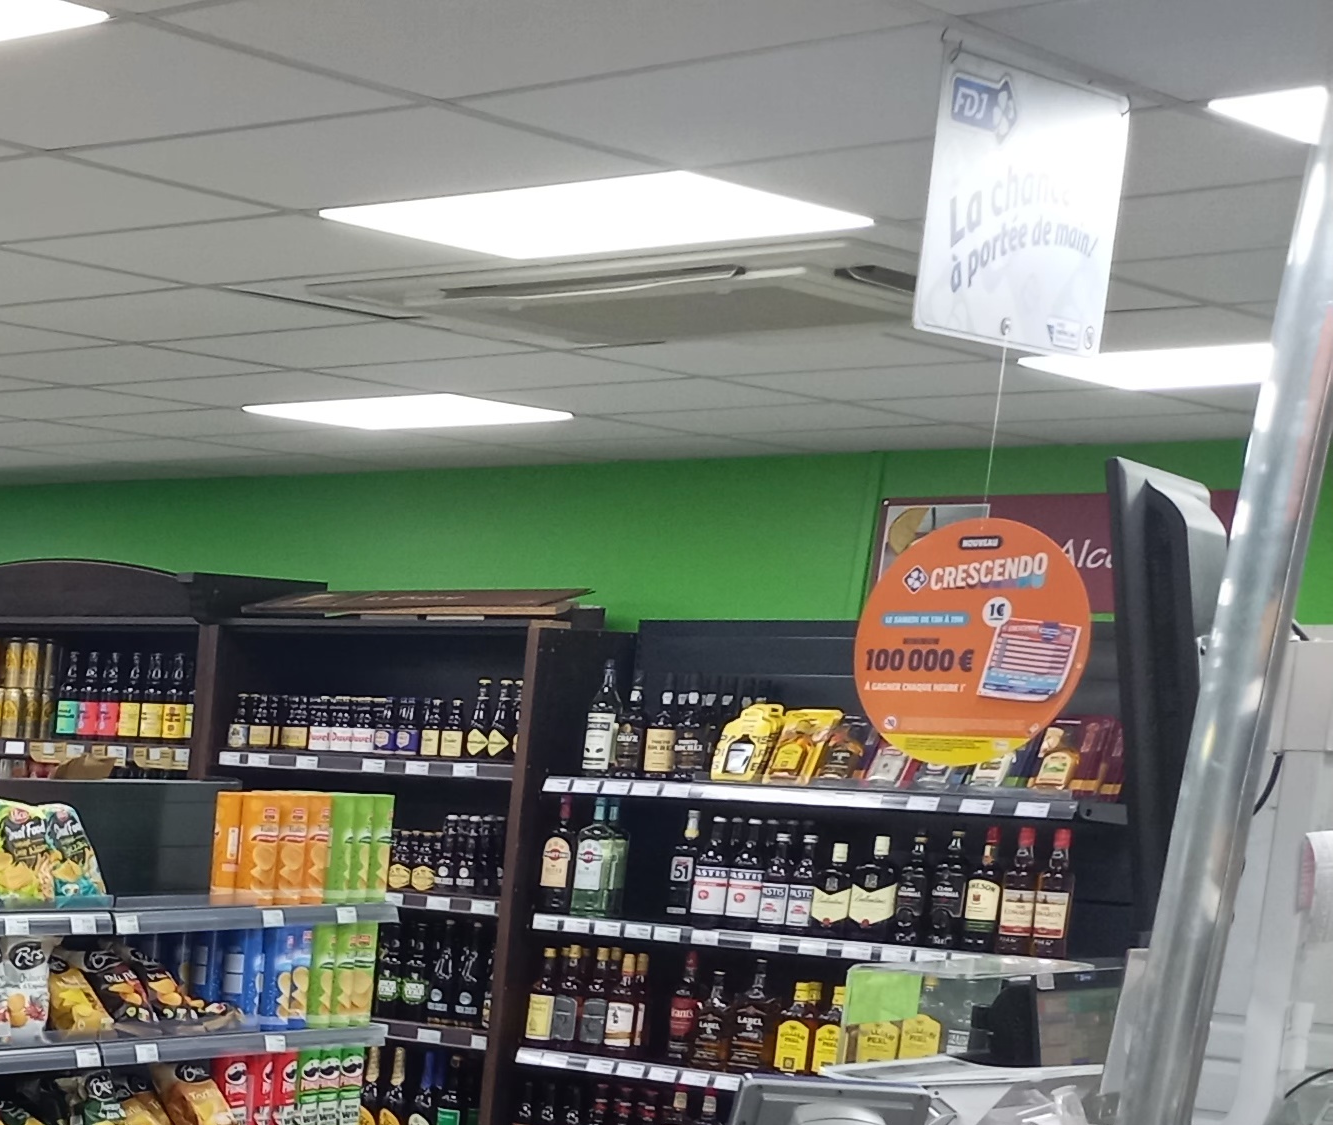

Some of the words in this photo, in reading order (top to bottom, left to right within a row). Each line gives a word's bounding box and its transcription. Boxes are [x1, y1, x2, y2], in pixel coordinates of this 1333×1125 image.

[954, 86, 987, 119] FDJ
[950, 194, 982, 248] La
[950, 249, 962, 293] à
[967, 216, 1028, 288] portée
[1032, 217, 1052, 248] de
[1054, 225, 1099, 258] main!
[930, 552, 1049, 591] CRESCENDO
[866, 649, 904, 672] 100
[908, 649, 955, 672] 000
[959, 649, 974, 672] €
[673, 864, 690, 880] 51
[695, 868, 728, 878] ASTIS
[698, 1020, 721, 1031] LABEL
[737, 1015, 764, 1028] LABEL
